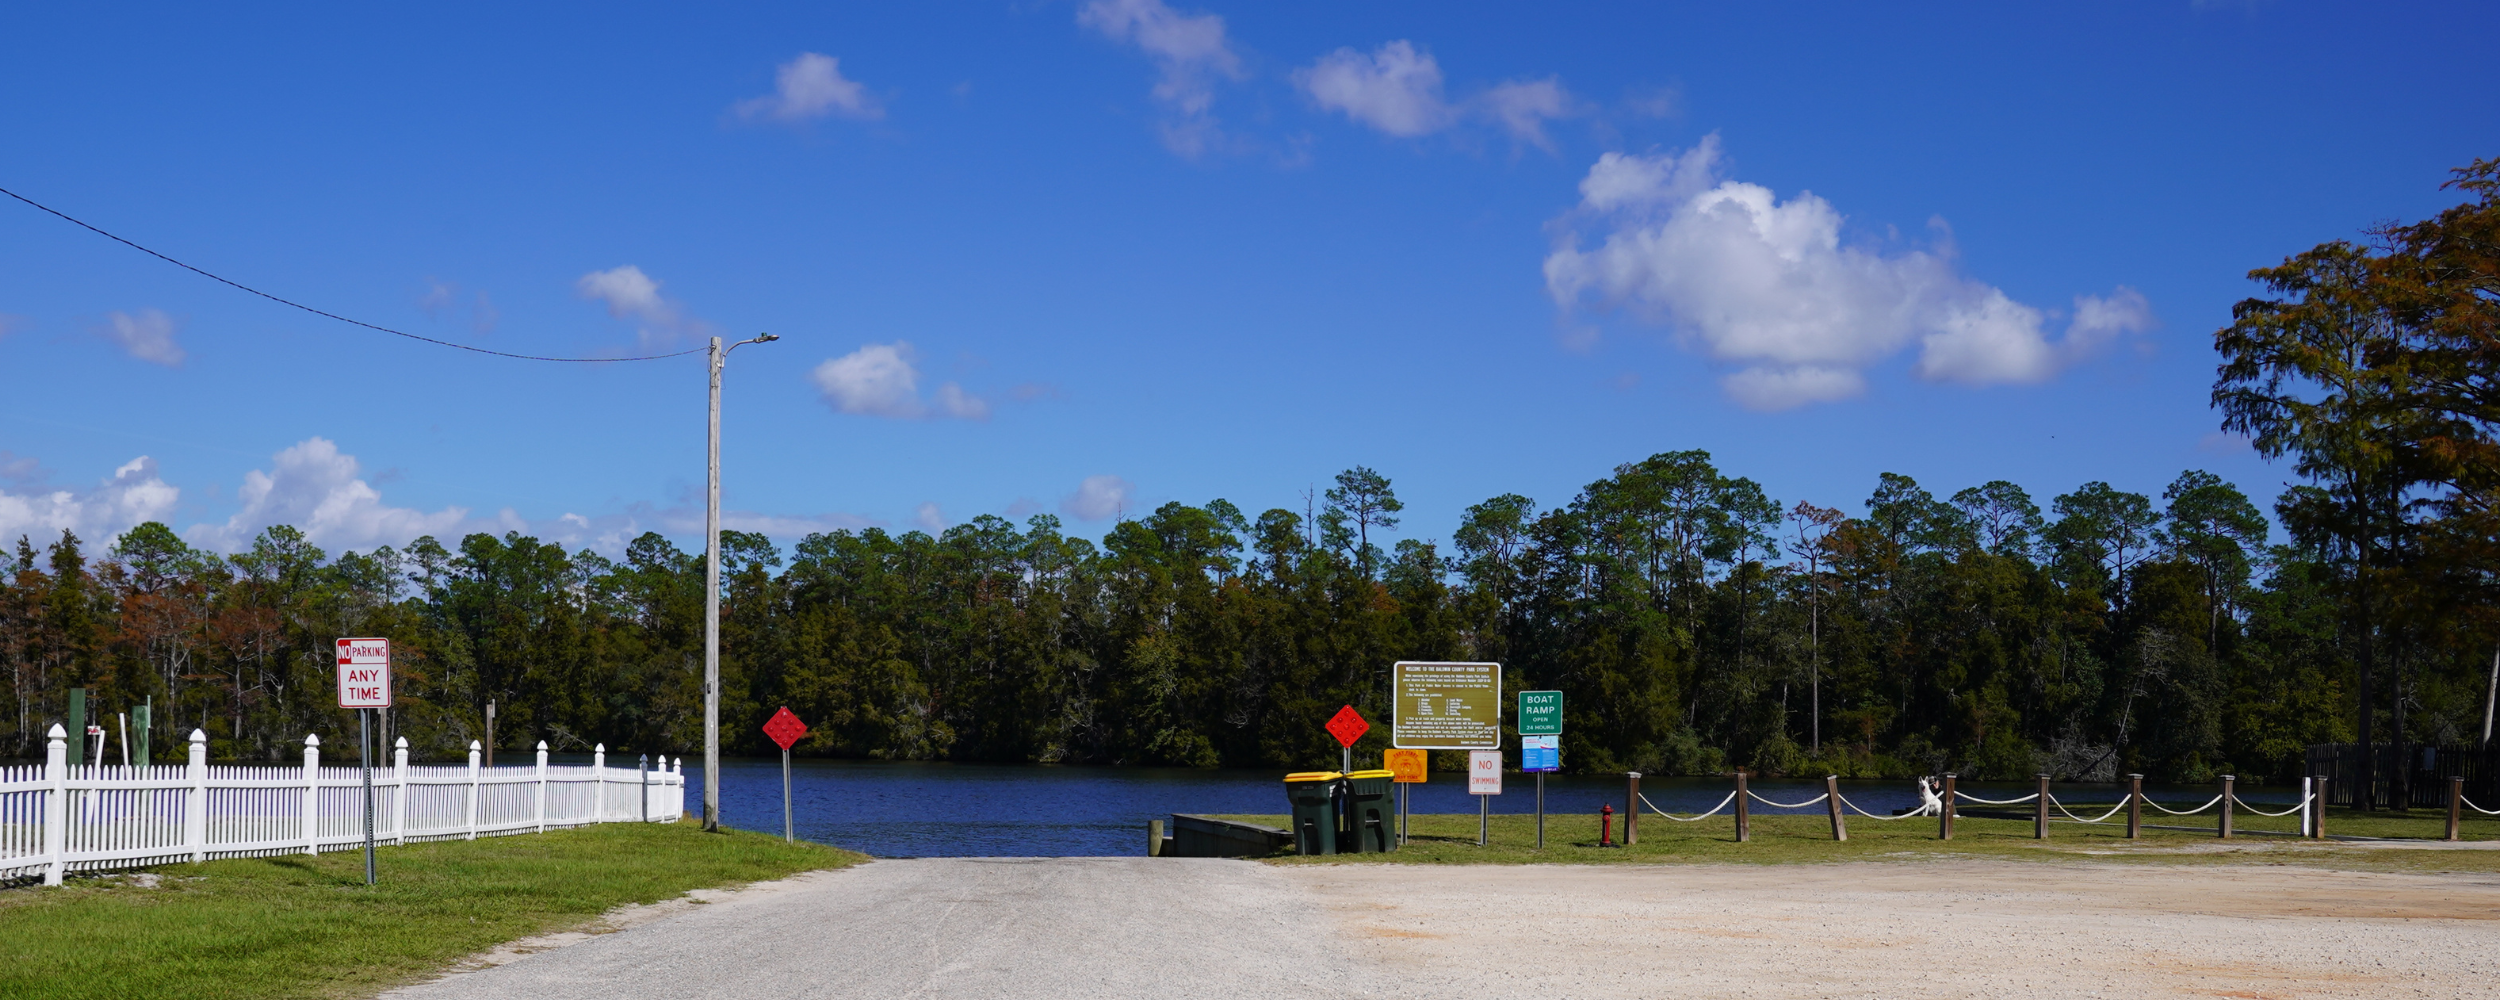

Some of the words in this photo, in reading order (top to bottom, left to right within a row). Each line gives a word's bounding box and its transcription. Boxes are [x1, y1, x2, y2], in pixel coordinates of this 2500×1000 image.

[338, 646, 350, 659] NO
[352, 647, 385, 657] PARKING
[349, 670, 379, 682] ANY
[348, 687, 380, 699] TIME
[1478, 760, 1492, 770] NO
